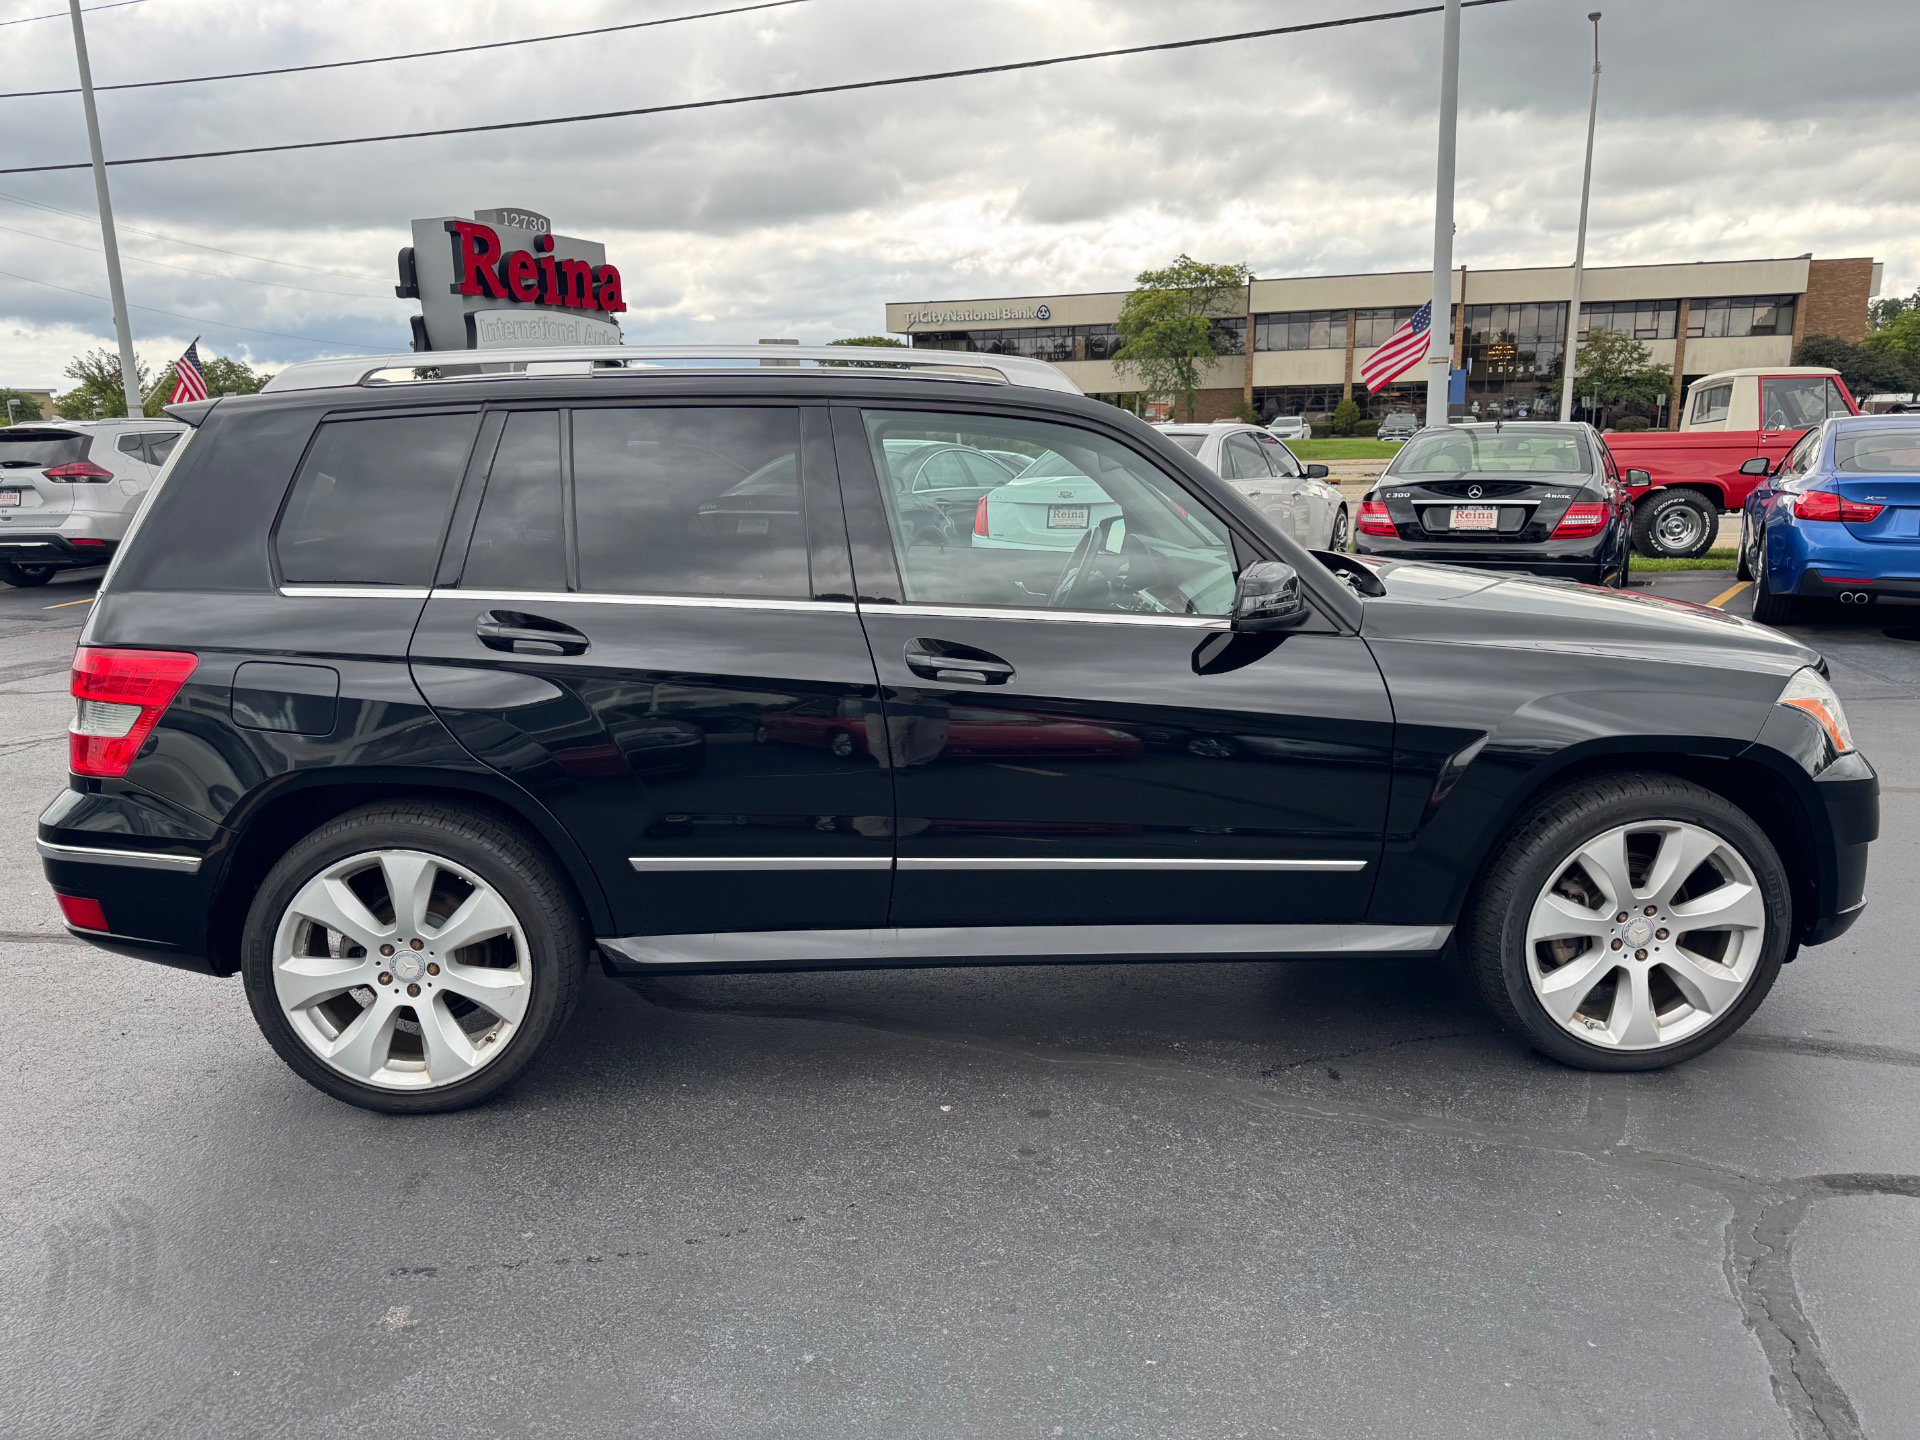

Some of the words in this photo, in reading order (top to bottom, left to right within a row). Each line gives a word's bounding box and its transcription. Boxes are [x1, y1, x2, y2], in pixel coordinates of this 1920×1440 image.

[502, 211, 547, 233] 12730
[452, 219, 627, 312] Reina
[948, 308, 1000, 322] National
[1002, 306, 1035, 320] Bank
[480, 318, 581, 344] International
[1053, 510, 1085, 518] Reina
[1455, 509, 1493, 519] Reina
[1654, 498, 1685, 515] COOPER
